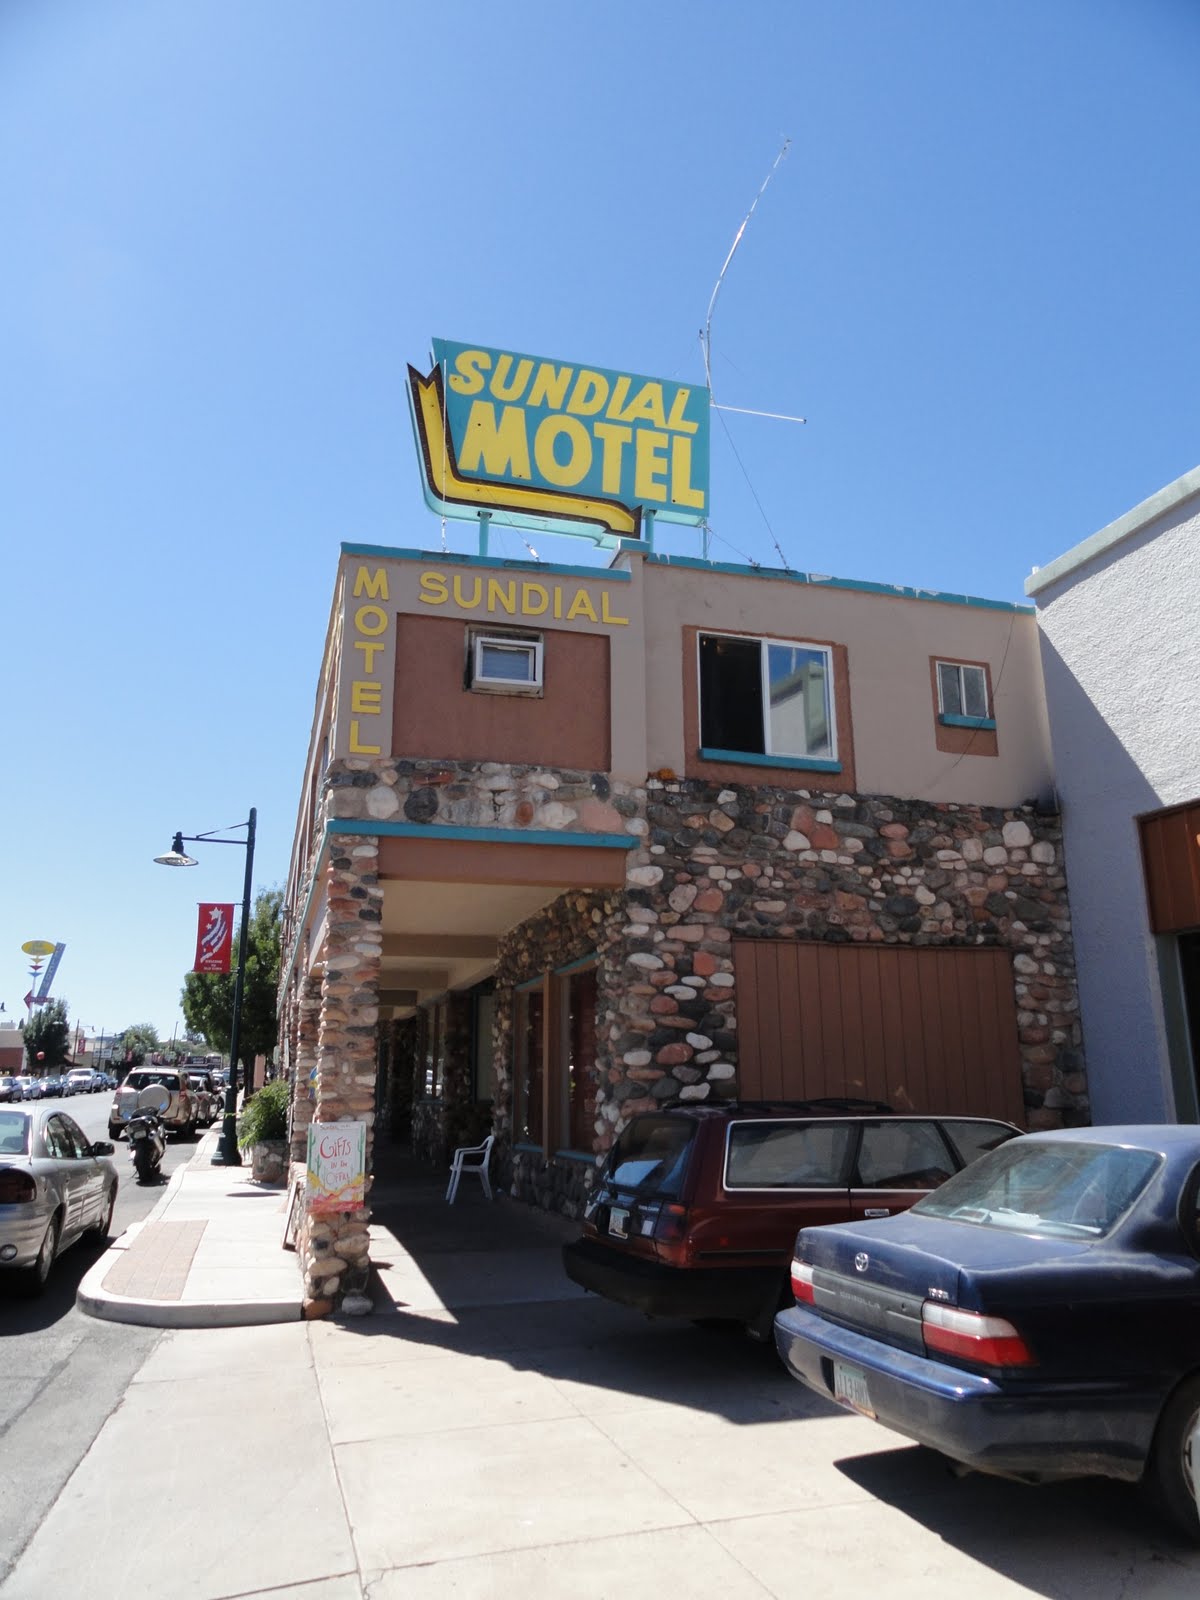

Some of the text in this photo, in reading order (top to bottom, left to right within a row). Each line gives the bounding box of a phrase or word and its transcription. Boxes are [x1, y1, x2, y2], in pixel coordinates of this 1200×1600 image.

[449, 350, 699, 434] SUNDIAL
[458, 400, 704, 509] MOTEL
[419, 571, 630, 626] SUNDIAL
[349, 566, 389, 755] MOTEL
